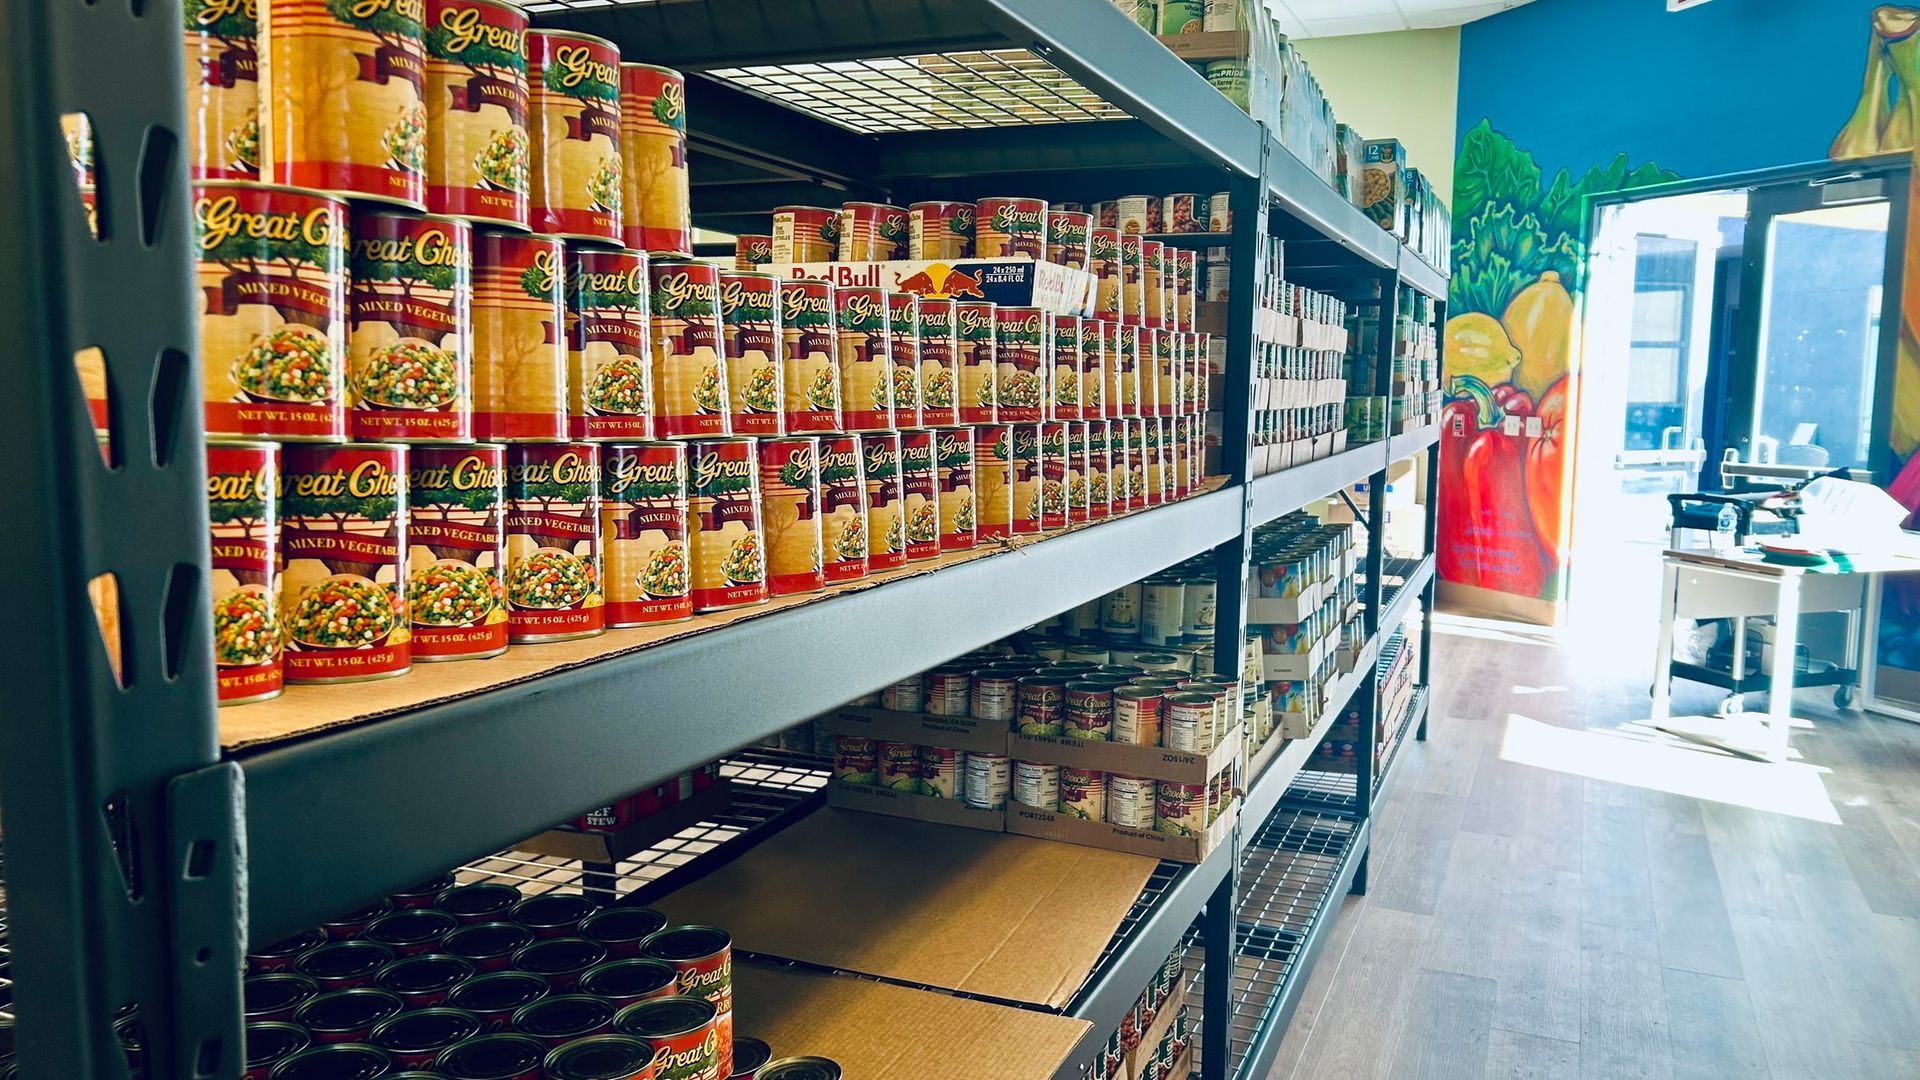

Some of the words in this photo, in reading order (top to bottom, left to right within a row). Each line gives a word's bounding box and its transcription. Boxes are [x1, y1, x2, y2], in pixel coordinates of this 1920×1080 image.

[440, 8, 518, 53] Great
[481, 85, 514, 102] MIXED
[591, 117, 617, 131] MIXED
[1368, 145, 1379, 155] 12
[480, 195, 498, 205] NET
[998, 204, 1038, 228] Great
[194, 196, 298, 250] Great
[839, 264, 879, 287] Bull
[1016, 274, 1024, 282] OZ
[238, 283, 290, 297] MIXED
[358, 302, 403, 313] MIXED
[586, 325, 621, 336] MIXED
[238, 410, 263, 421] NET
[264, 410, 288, 421] WT.
[291, 411, 302, 422] 15
[361, 416, 380, 427] NET
[381, 416, 403, 427] WT.
[405, 417, 415, 428] 15
[416, 417, 432, 428] OZ.
[812, 414, 825, 422] NET
[589, 421, 606, 430] NET
[608, 421, 623, 430] WT.
[624, 421, 633, 430] 15
[633, 422, 643, 430] OZ.
[699, 419, 714, 428] NET
[606, 453, 675, 493] Great
[722, 505, 750, 517] MIXED
[640, 513, 671, 525] MIXED
[409, 526, 440, 537] IXED
[289, 538, 336, 550] MIXED
[727, 591, 740, 599] NET
[642, 605, 655, 614] NET
[656, 604, 672, 613] WT.
[524, 616, 540, 627] WT.
[542, 616, 551, 626] 15
[552, 615, 566, 625] OZ.
[420, 633, 440, 644] WT.
[441, 633, 451, 643] 15
[452, 632, 466, 643] OZ.
[290, 658, 312, 668] NET
[313, 658, 335, 668] WT.
[337, 657, 349, 667] 15
[349, 656, 365, 667] OZ.
[587, 816, 616, 826] STEW
[1112, 828, 1137, 839] Product
[1138, 832, 1146, 840] of
[1145, 832, 1165, 842] China
